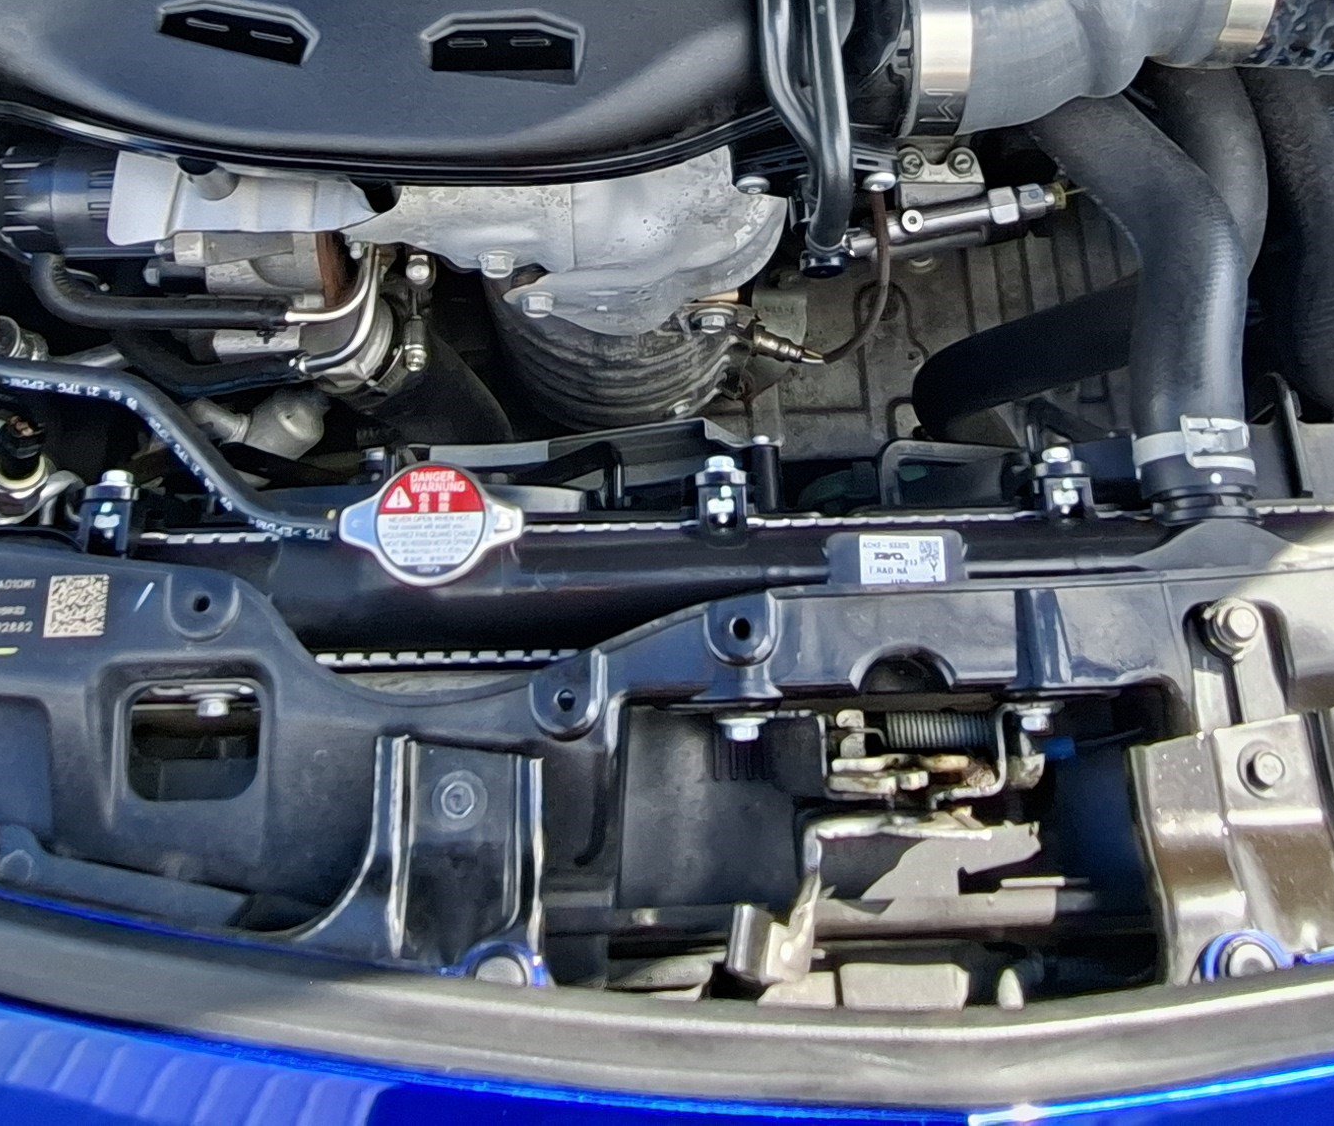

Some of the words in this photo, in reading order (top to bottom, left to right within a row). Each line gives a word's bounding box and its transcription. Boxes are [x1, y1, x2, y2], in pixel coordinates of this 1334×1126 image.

[55, 380, 82, 395] TPC
[410, 470, 456, 483] DANGER
[410, 480, 467, 493] WARNUNG
